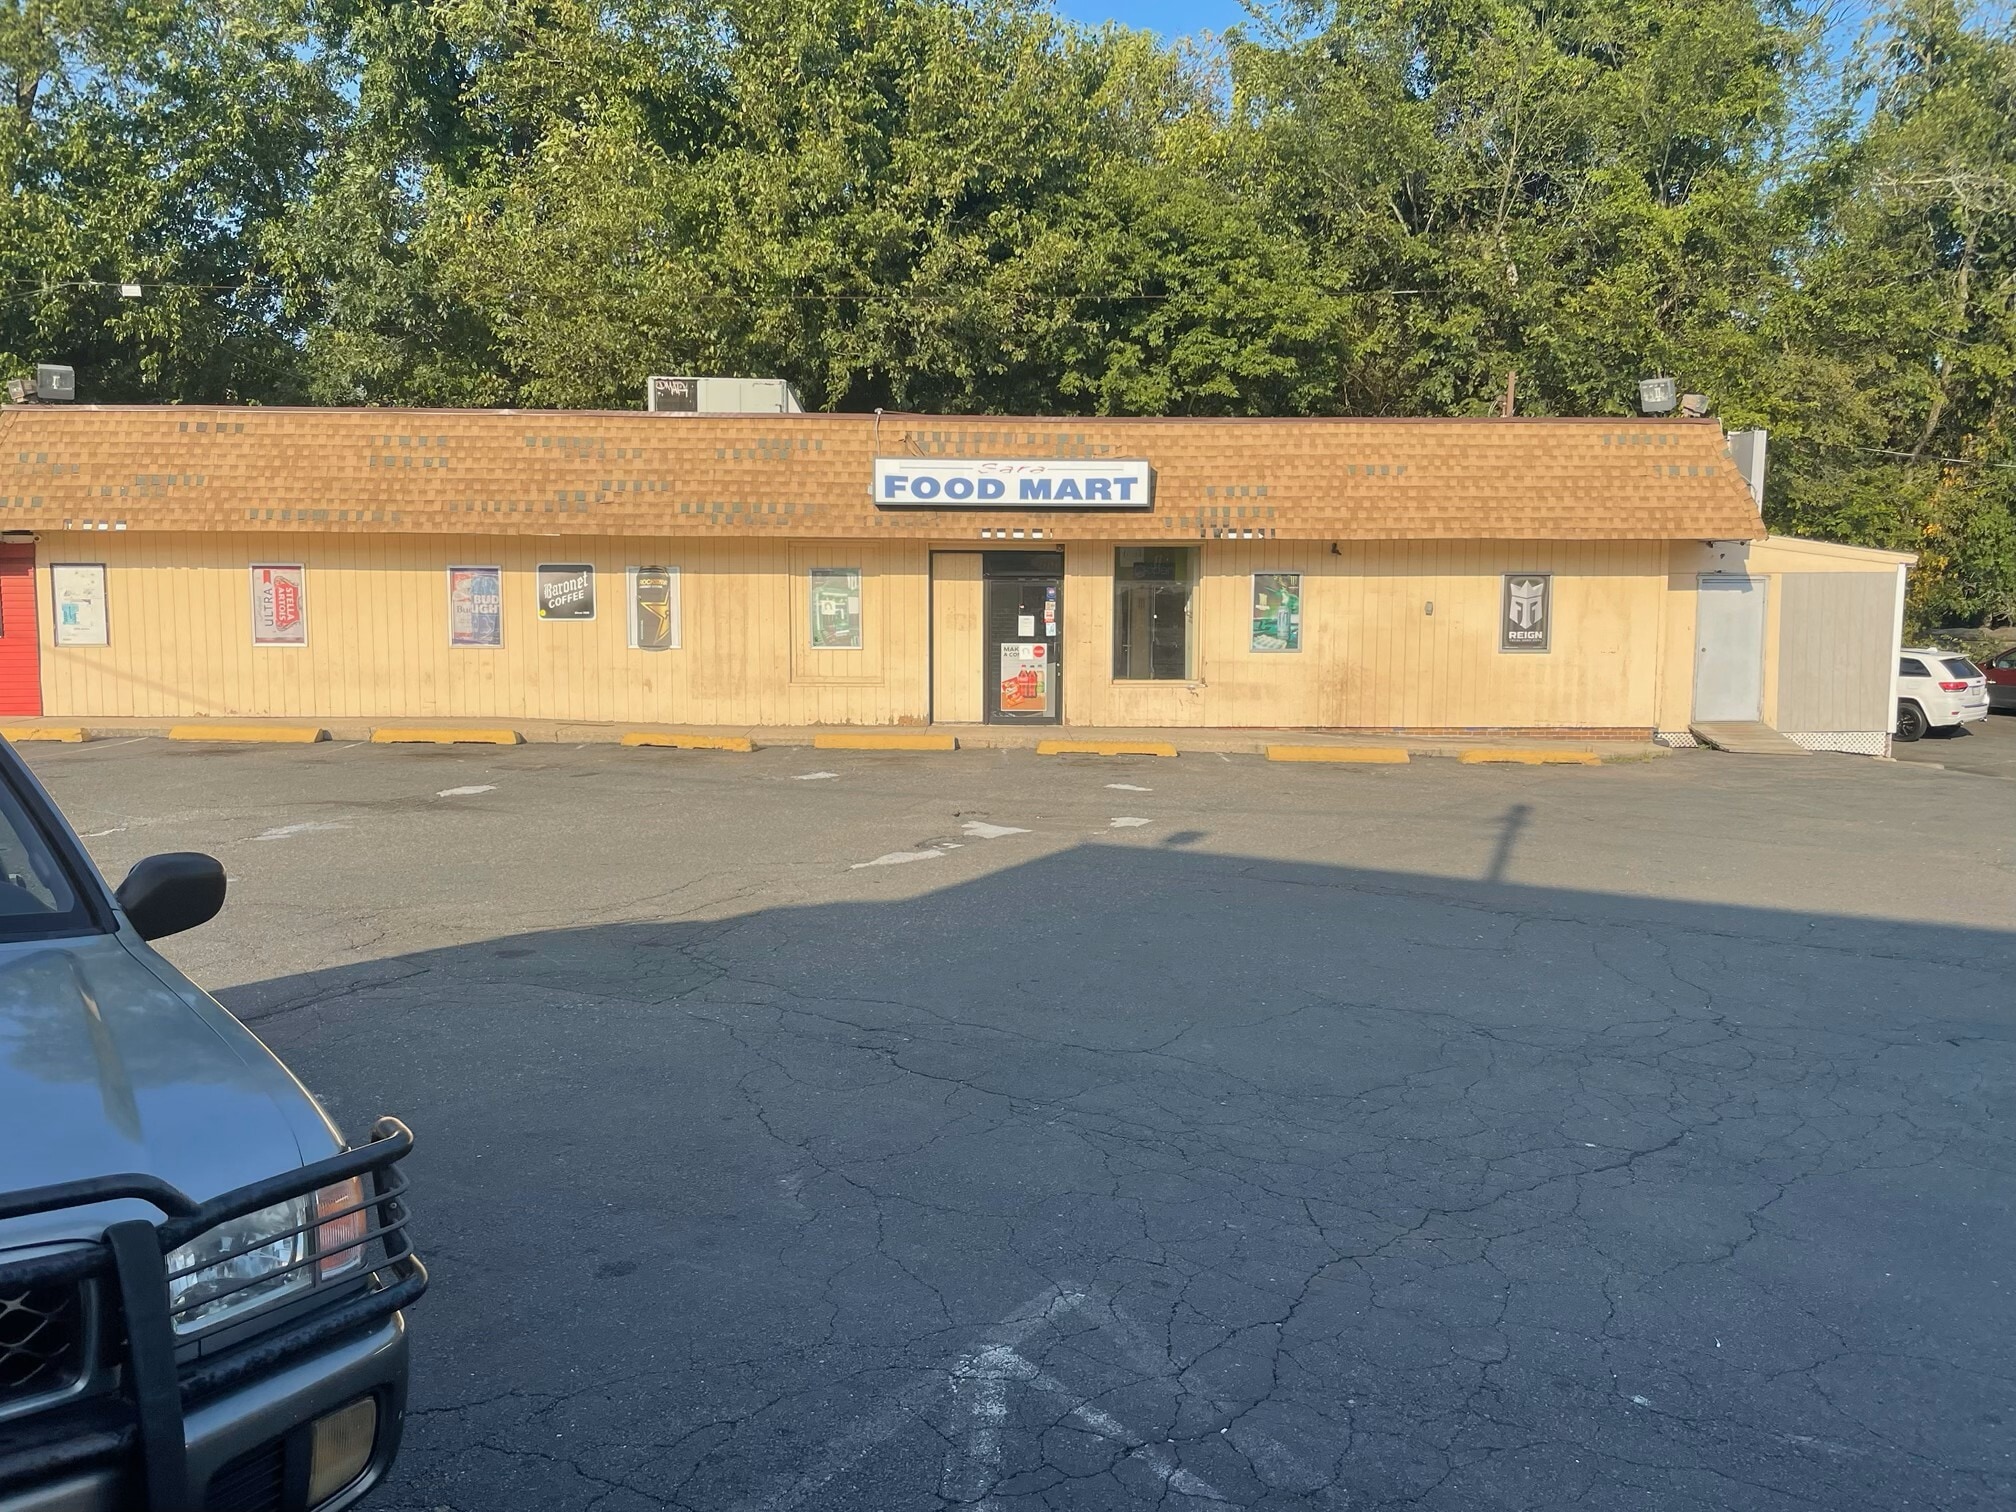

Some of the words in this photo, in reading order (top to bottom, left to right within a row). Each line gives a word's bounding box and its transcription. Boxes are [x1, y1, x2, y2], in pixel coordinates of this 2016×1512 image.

[978, 462, 1046, 474] Sara
[884, 475, 1006, 500] FOOD
[1019, 477, 1139, 501] MART
[543, 571, 588, 599] Baronet
[263, 588, 273, 627] ULTRA
[286, 587, 295, 620] STELLA
[473, 594, 499, 604] BUD
[548, 590, 584, 609] COFFEE
[1508, 631, 1543, 639] REIGN
